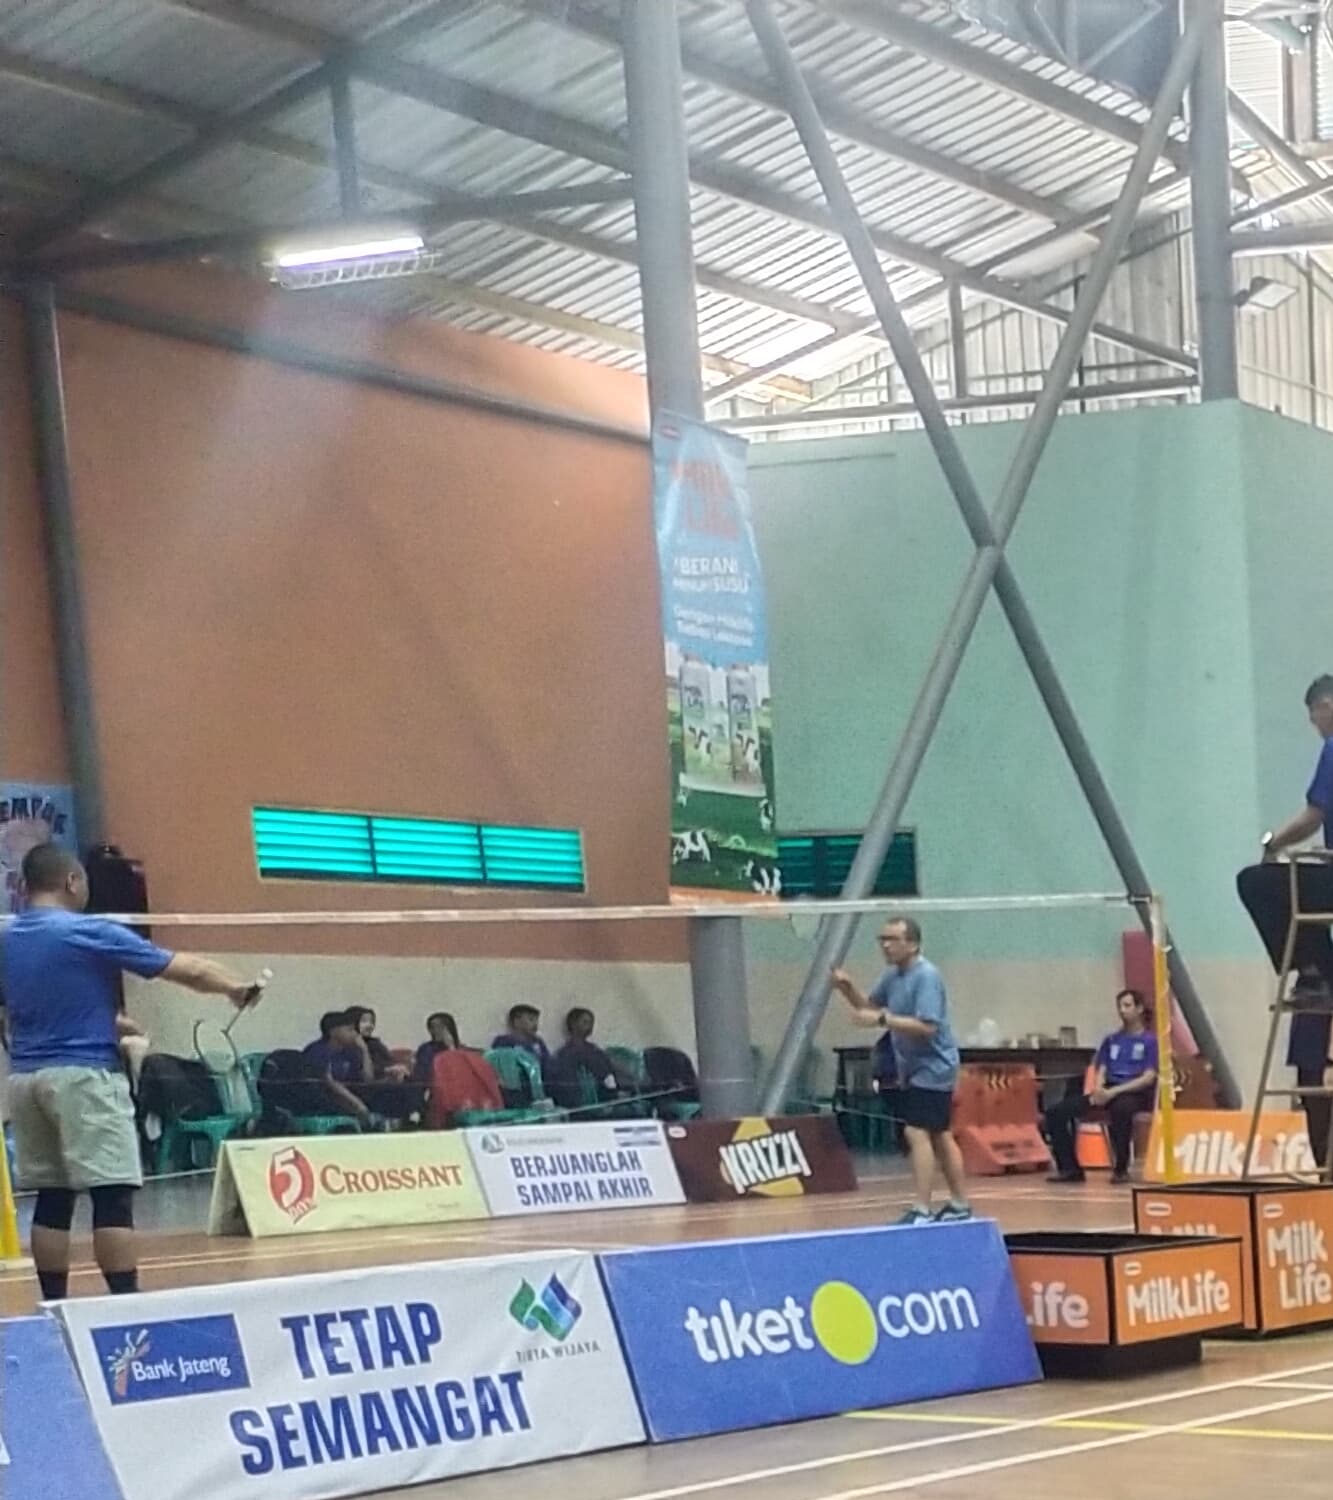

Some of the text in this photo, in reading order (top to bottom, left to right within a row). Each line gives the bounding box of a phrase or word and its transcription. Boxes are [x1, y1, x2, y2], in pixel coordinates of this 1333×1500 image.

[320, 1164, 463, 1195] CROISSANT
[510, 1149, 642, 1178] BERJUANGLAH
[517, 1178, 653, 1206] SAMPAI AKHIR
[1267, 1220, 1329, 1267] Milk
[1127, 1268, 1231, 1327] MilkLife
[1279, 1264, 1333, 1309] Life
[280, 1301, 443, 1380] TETAP
[132, 1355, 231, 1383] Bank Jateng
[228, 1370, 532, 1476] SEMANGAT
